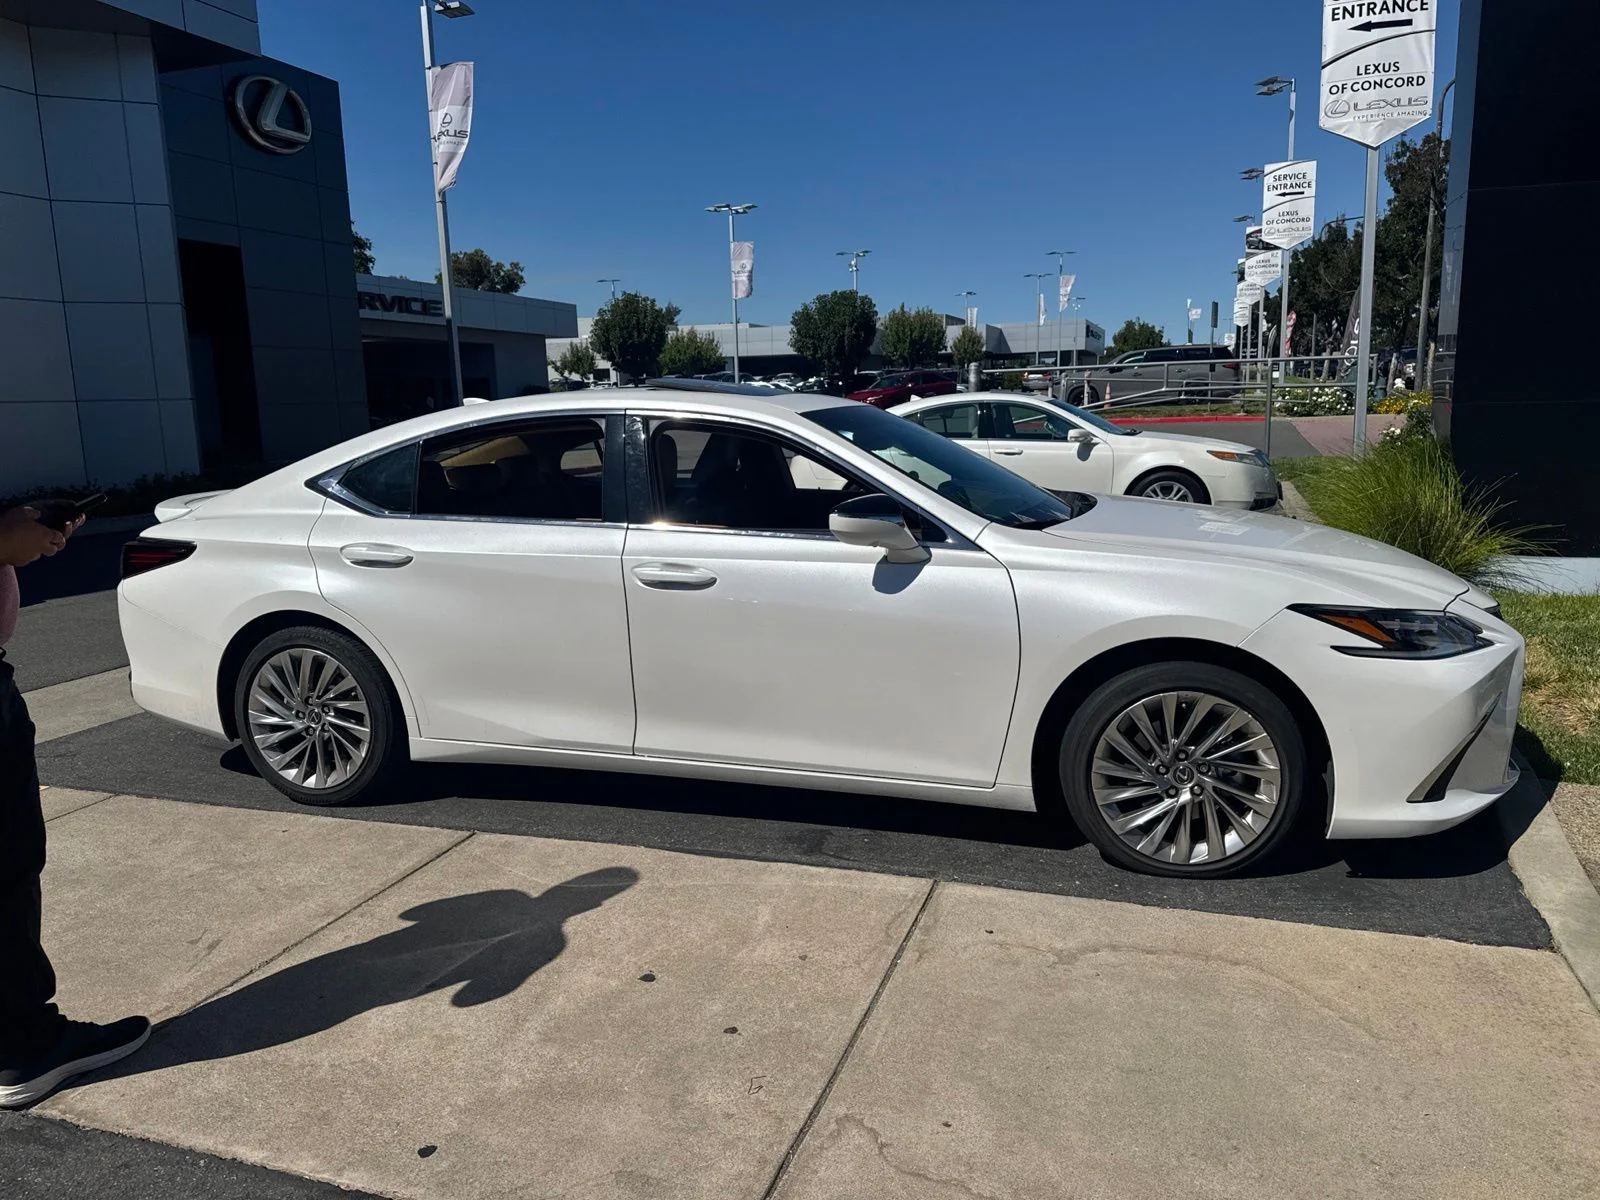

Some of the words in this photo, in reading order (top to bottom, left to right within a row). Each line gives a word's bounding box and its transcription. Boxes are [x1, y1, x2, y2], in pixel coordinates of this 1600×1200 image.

[1331, 0, 1429, 21] ENTRANCE
[1356, 61, 1400, 76] LEXUS
[1328, 83, 1348, 95] OF
[1350, 75, 1426, 93] CONCORD
[1353, 96, 1428, 111] LEXUS
[1273, 172, 1307, 182] SERVICE
[1267, 181, 1312, 191] ENTRANCE
[1276, 216, 1311, 225] CONCORD
